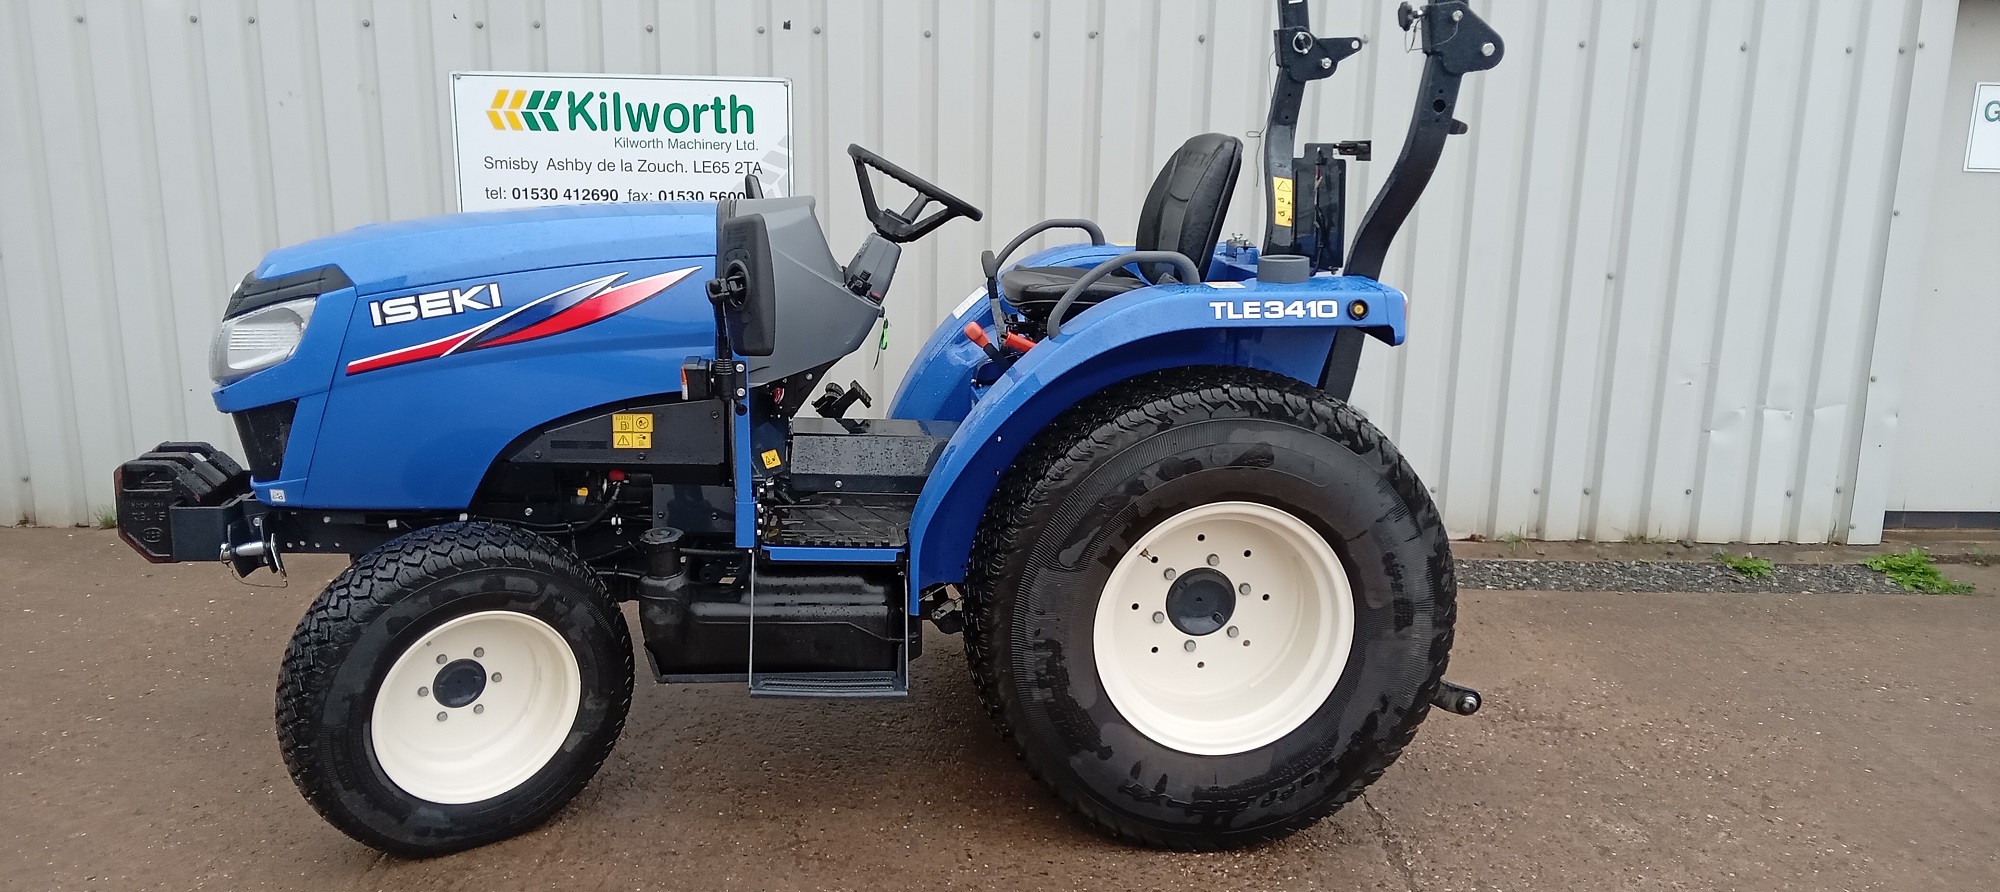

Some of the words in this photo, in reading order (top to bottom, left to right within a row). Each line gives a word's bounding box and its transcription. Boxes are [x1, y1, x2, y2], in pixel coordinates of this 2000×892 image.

[567, 90, 755, 135] Kilworth
[614, 137, 664, 149] Kilworth
[667, 138, 732, 154] Machinery
[736, 139, 759, 151] Ltd.
[484, 155, 539, 174] Smisby
[546, 157, 593, 175] Ashby
[597, 158, 616, 172] de
[620, 159, 633, 172] la
[637, 159, 688, 173] Zouch.
[693, 160, 730, 174] LE65
[734, 161, 763, 175] 2TA
[485, 187, 507, 199] tel:
[511, 187, 559, 200] 01530
[563, 188, 619, 202] 412690
[627, 189, 653, 201] fax:
[658, 190, 704, 201] 01530
[369, 282, 503, 328] ISEKI
